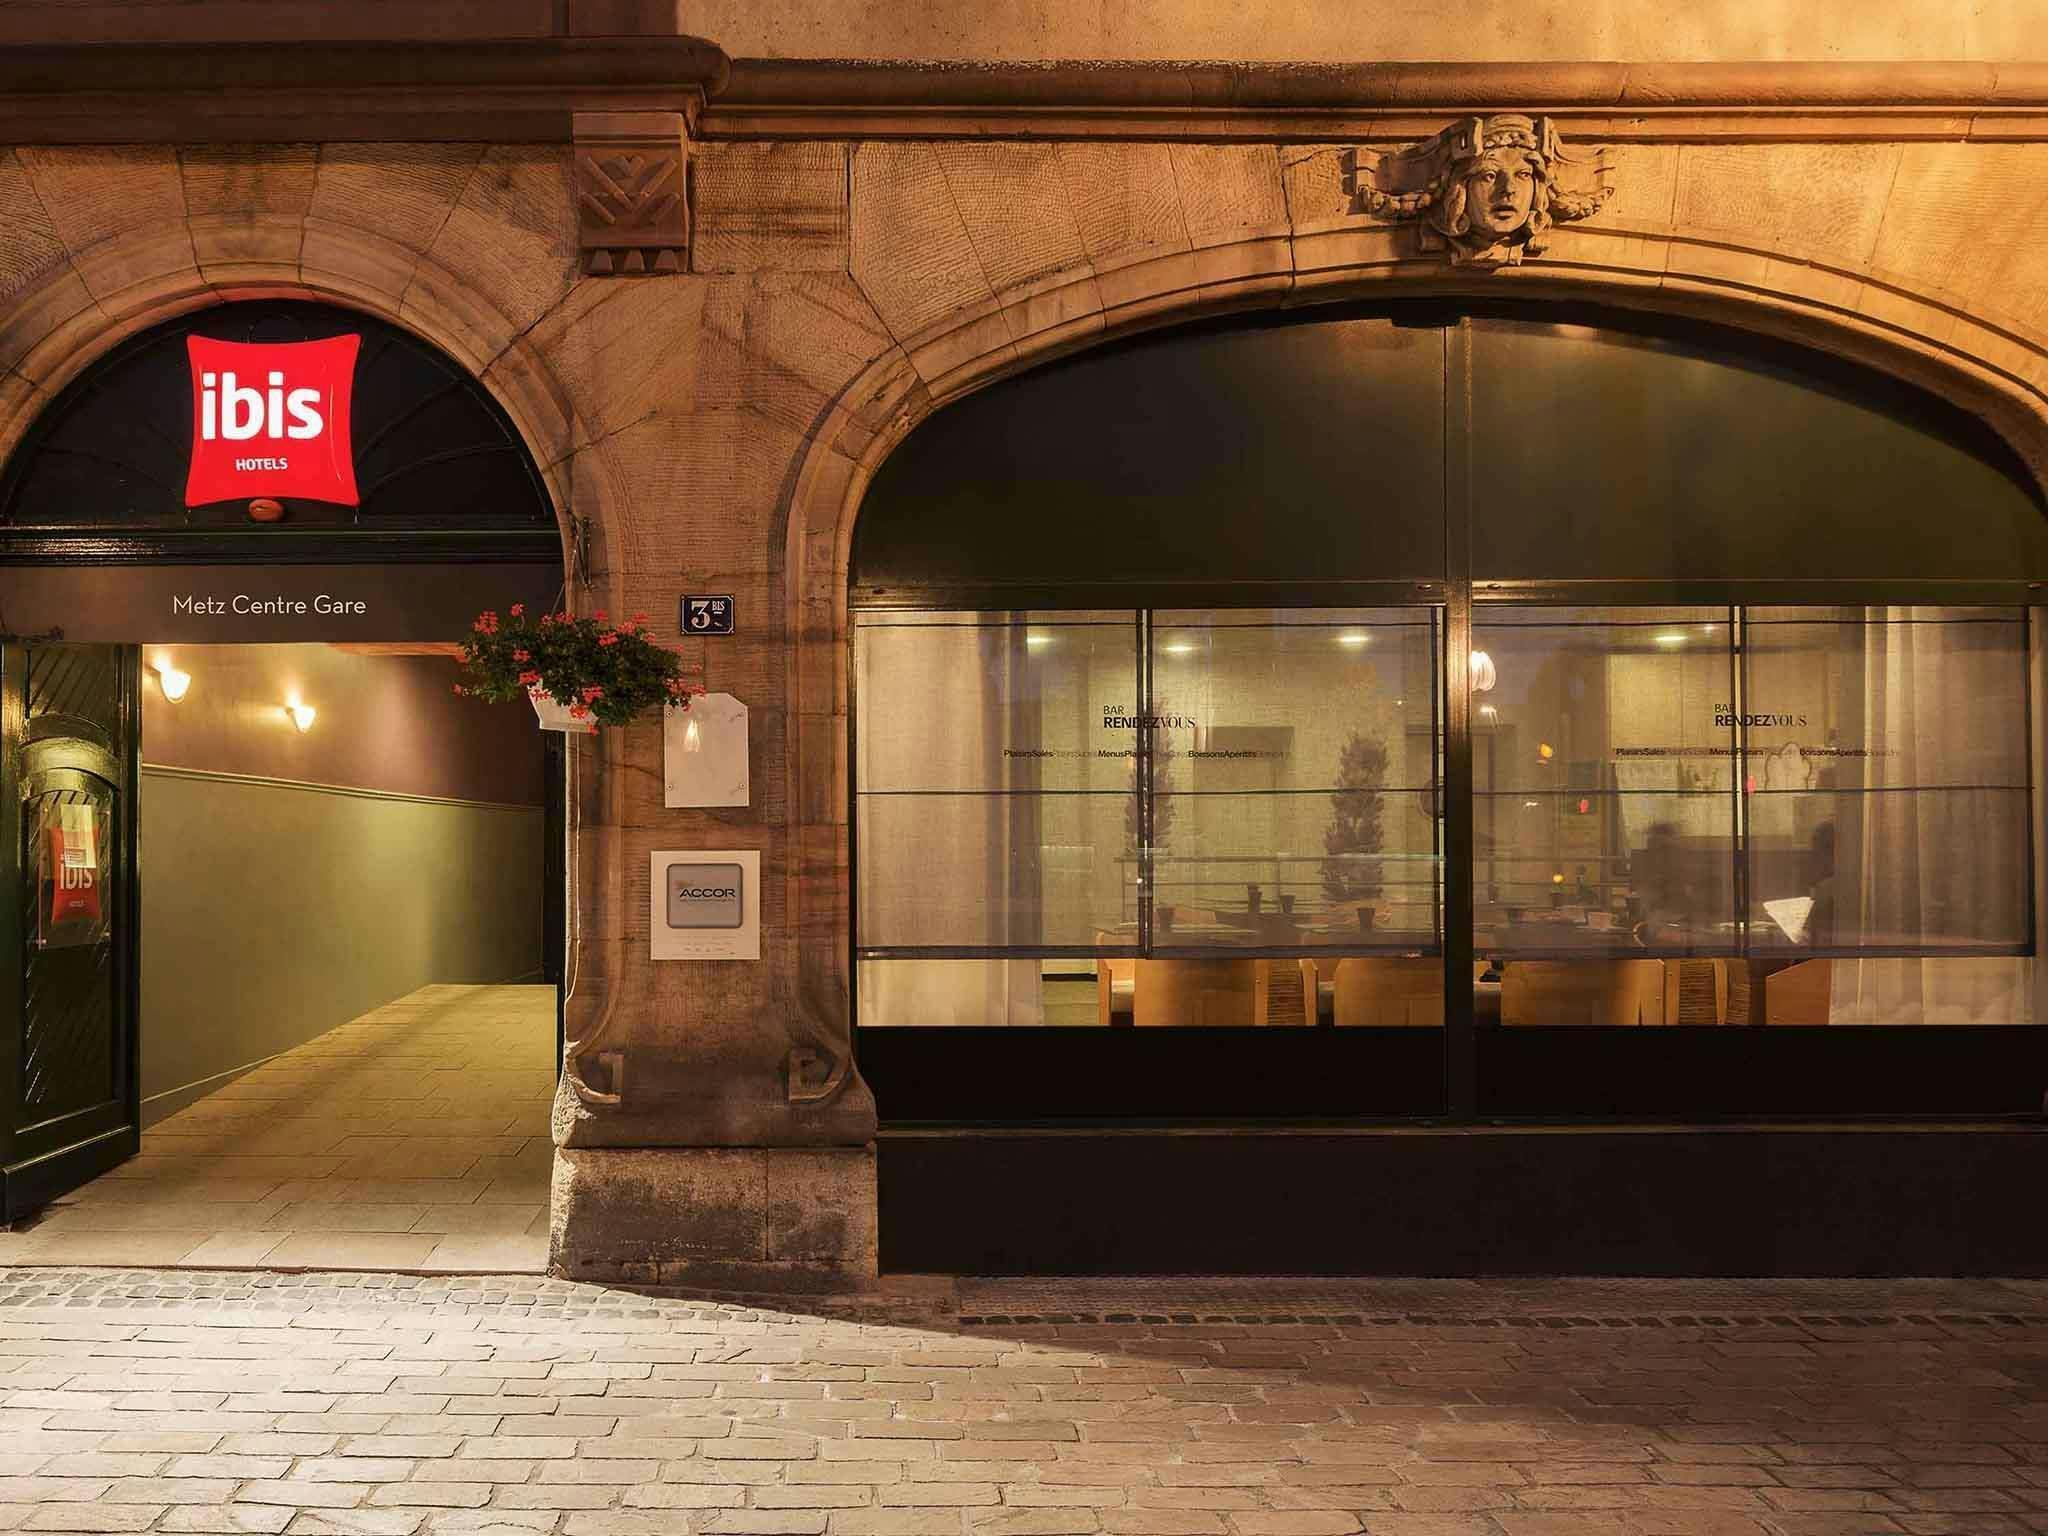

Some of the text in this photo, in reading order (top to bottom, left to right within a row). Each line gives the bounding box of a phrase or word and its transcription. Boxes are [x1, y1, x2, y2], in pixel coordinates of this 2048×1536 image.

[201, 371, 324, 441] ibis
[235, 457, 288, 471] HOTELS
[173, 594, 367, 615] Metz Centre Gare
[690, 600, 725, 629] 3 BIS
[1103, 705, 1125, 715] BAR
[679, 888, 736, 898] ACCOR
